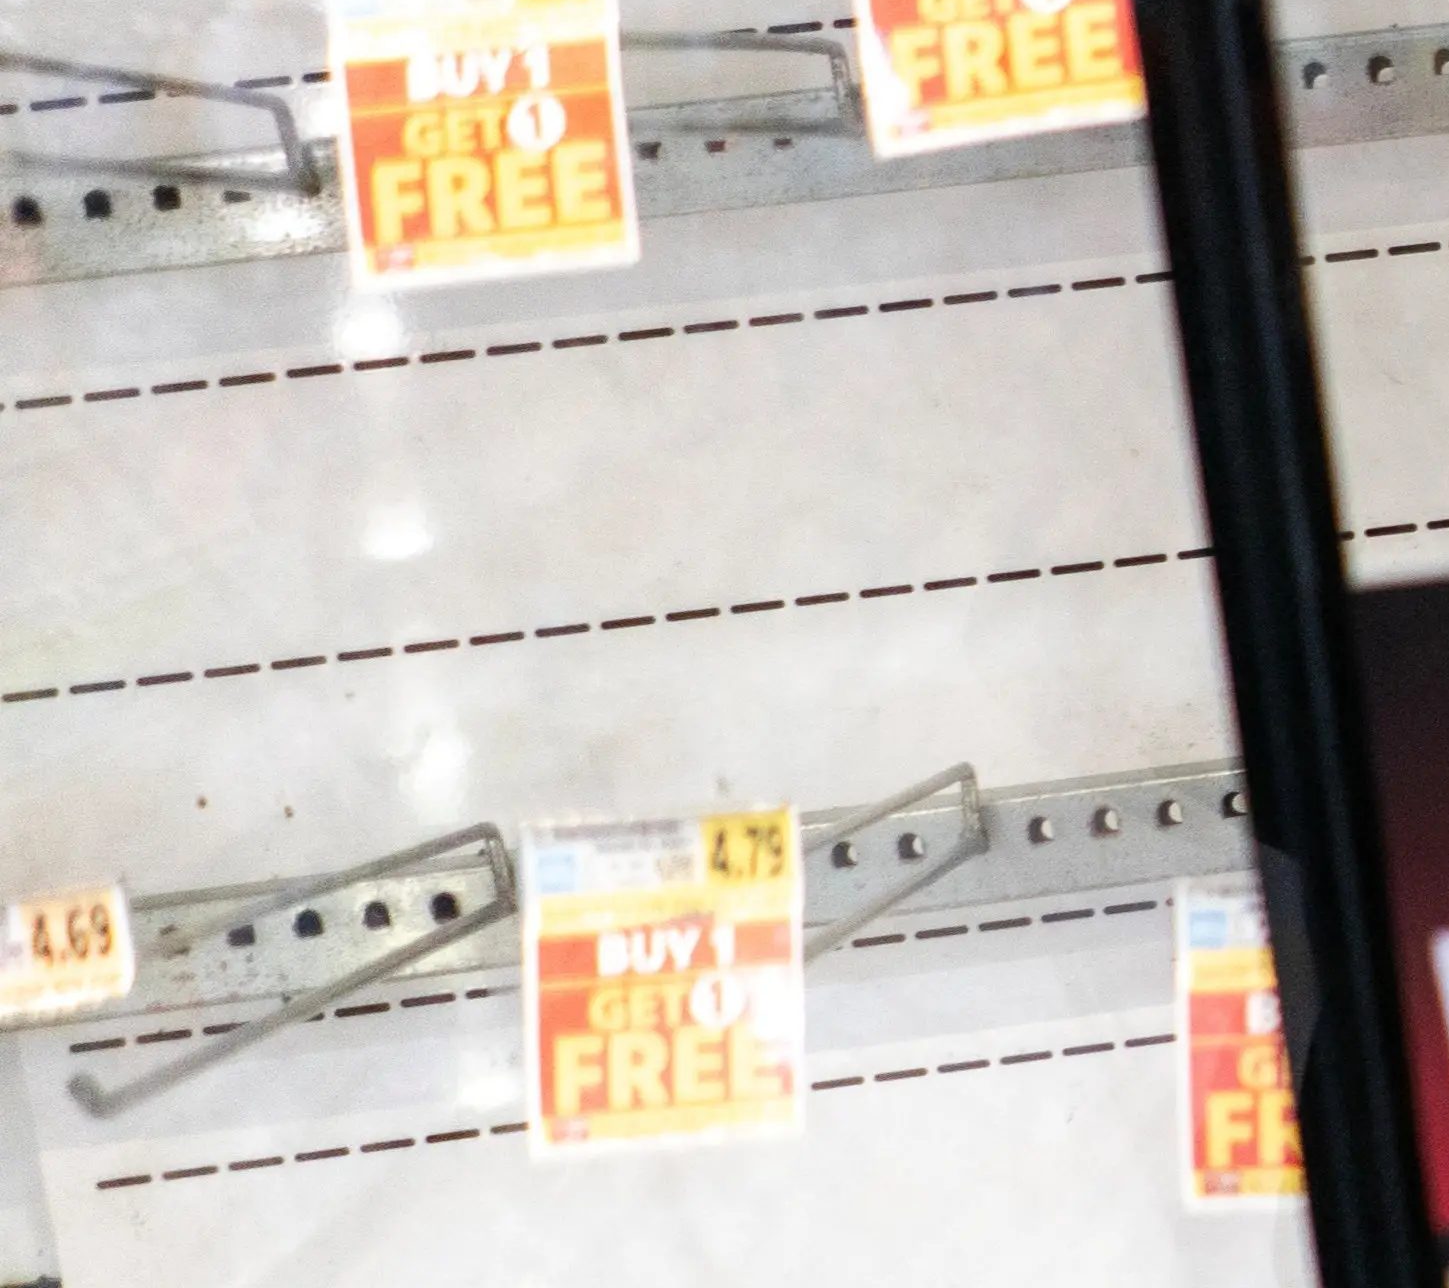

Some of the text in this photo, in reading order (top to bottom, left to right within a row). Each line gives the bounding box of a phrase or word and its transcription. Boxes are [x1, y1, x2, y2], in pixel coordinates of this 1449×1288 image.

[405, 44, 551, 102] BUY 1
[891, 2, 1122, 111] FREE
[404, 108, 501, 157] GET
[371, 141, 613, 247] FREE
[710, 824, 784, 878] 4.79
[34, 904, 112, 965] 4.69
[597, 923, 736, 977] BUY 1
[588, 981, 691, 1029] GET
